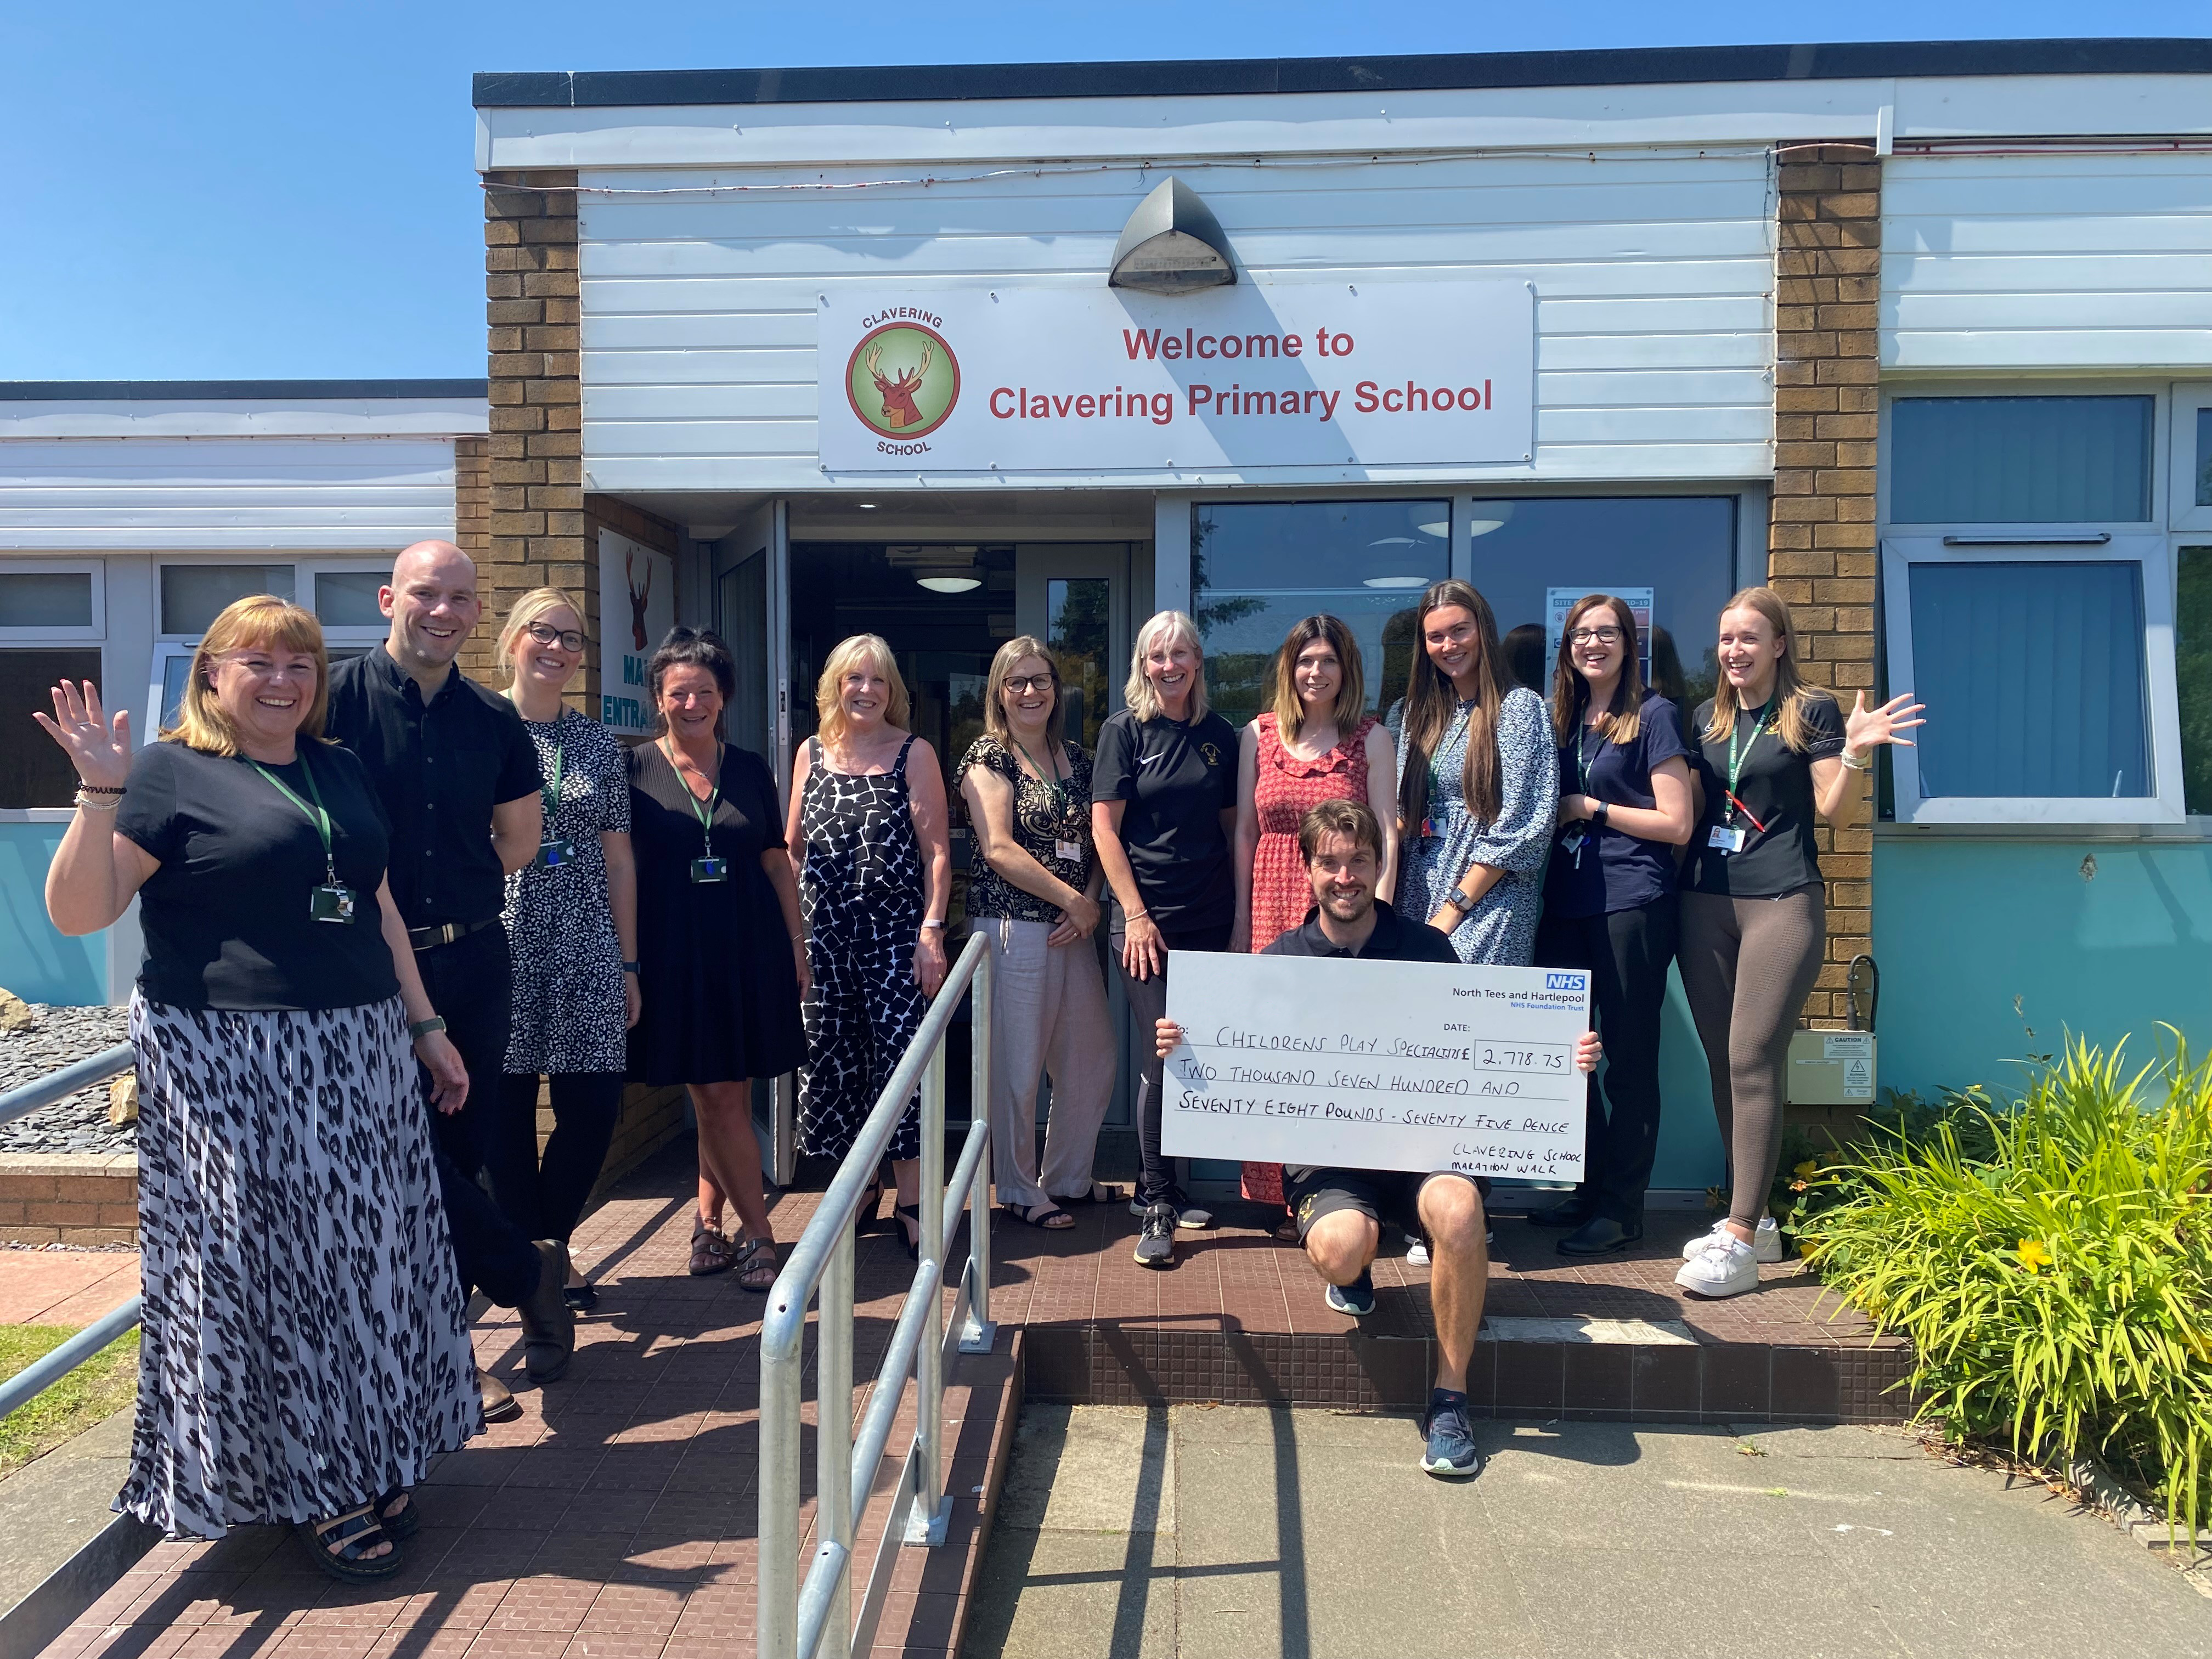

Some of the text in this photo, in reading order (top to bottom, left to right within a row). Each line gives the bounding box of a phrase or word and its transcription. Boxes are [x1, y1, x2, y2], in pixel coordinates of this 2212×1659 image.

[862, 307, 943, 328] CLAVERING
[1122, 327, 1354, 360] Welcome to
[990, 379, 1492, 425] Clavering Primary School
[877, 441, 932, 456] SCHOOL
[1547, 974, 1585, 990] NHS
[1453, 988, 1584, 1003] North Tees and Hartlepool
[1443, 1023, 1470, 1032] DATE:
[1217, 1026, 1327, 1051] CHILDRENS
[1341, 1034, 1378, 1052] PLAY
[1178, 1058, 1519, 1095] TWO THOUSAND SEVEN HUNDRED AND
[1179, 1090, 1256, 1114] SEVENTY
[1265, 1099, 1319, 1117] EIGHT
[1325, 1102, 1384, 1121] POUNDS
[1402, 1109, 1466, 1128] SEVENTY
[1475, 1114, 1512, 1130] FIVE
[1523, 1118, 1570, 1132] PENCE
[1453, 1143, 1582, 1163] CLAVERING SCHOOL
[1452, 1161, 1556, 1175] MARATHON WALK
